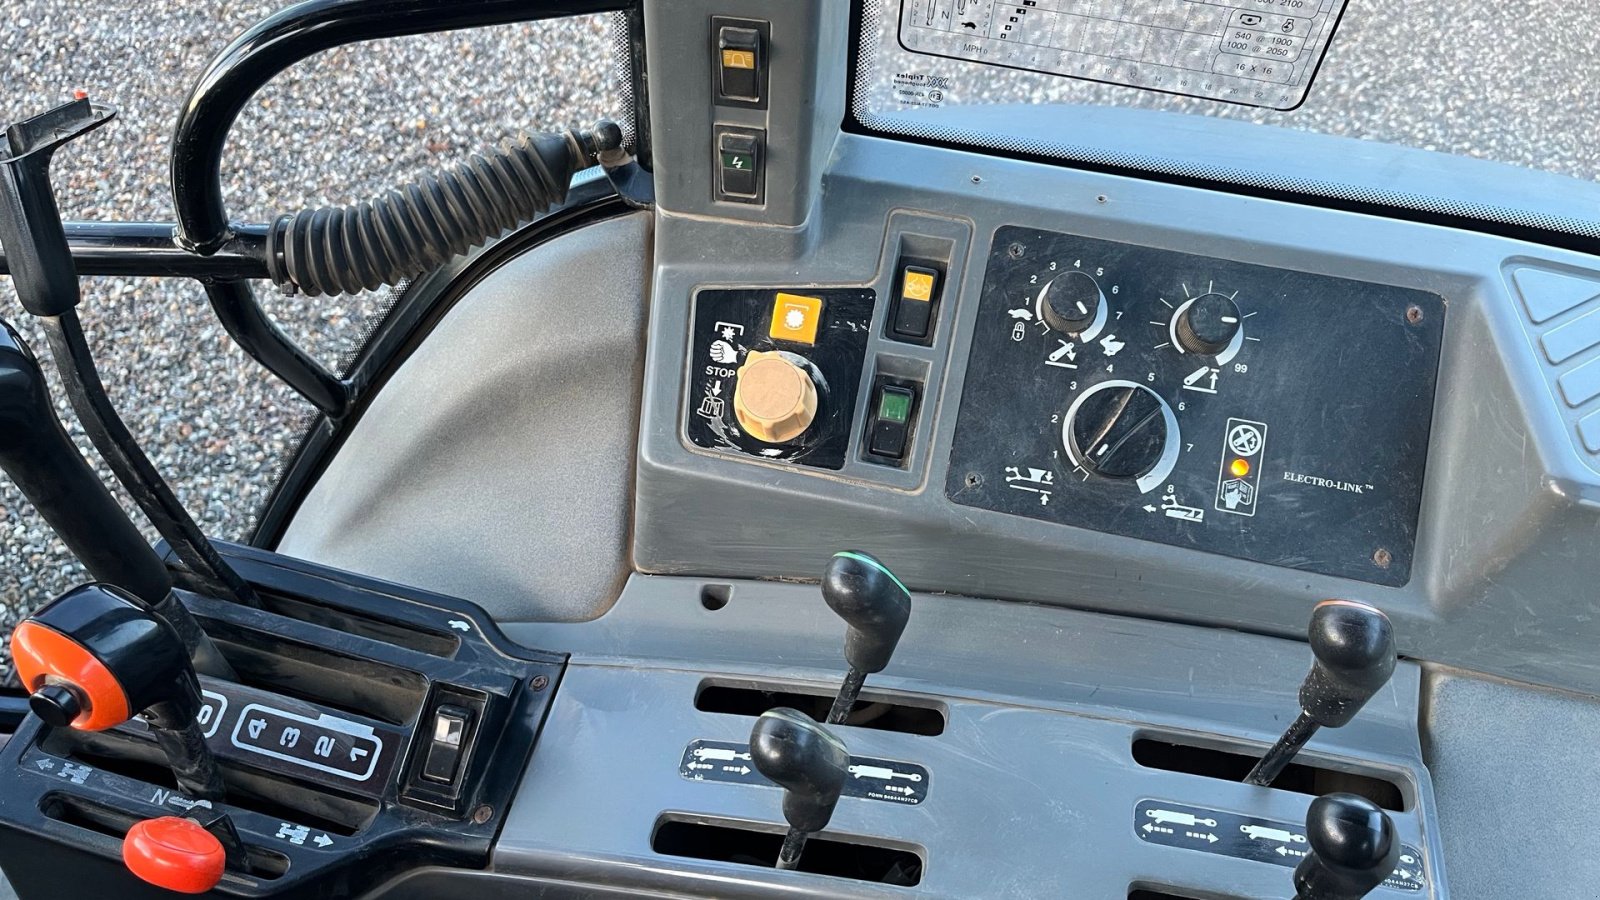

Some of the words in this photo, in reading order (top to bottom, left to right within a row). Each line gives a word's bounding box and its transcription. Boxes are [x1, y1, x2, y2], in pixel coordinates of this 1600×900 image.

[941, 10, 950, 19] N
[1272, 37, 1292, 46] 1900
[963, 43, 982, 53] MPH
[1227, 42, 1247, 50] 1000
[1266, 47, 1288, 56] 2050
[1050, 262, 1056, 270] 3
[1074, 260, 1081, 268] 4
[1096, 268, 1104, 276] 5
[1030, 275, 1037, 283] 2
[1112, 286, 1119, 294] 6
[1116, 312, 1123, 320] 7
[705, 365, 736, 378] STOP
[1106, 364, 1114, 373] 4
[1235, 364, 1248, 373] 99
[1148, 373, 1155, 381] 5
[1070, 382, 1077, 390] 3
[1178, 402, 1185, 410] 6
[1051, 415, 1058, 423] 2
[1186, 444, 1193, 452] 7
[1283, 471, 1363, 494] ELECTRO-LINK
[1167, 485, 1174, 493] 8
[248, 718, 267, 739] 4
[280, 727, 300, 748] 3
[314, 736, 335, 757] 2
[350, 747, 368, 761] 1
[150, 789, 170, 805] N
